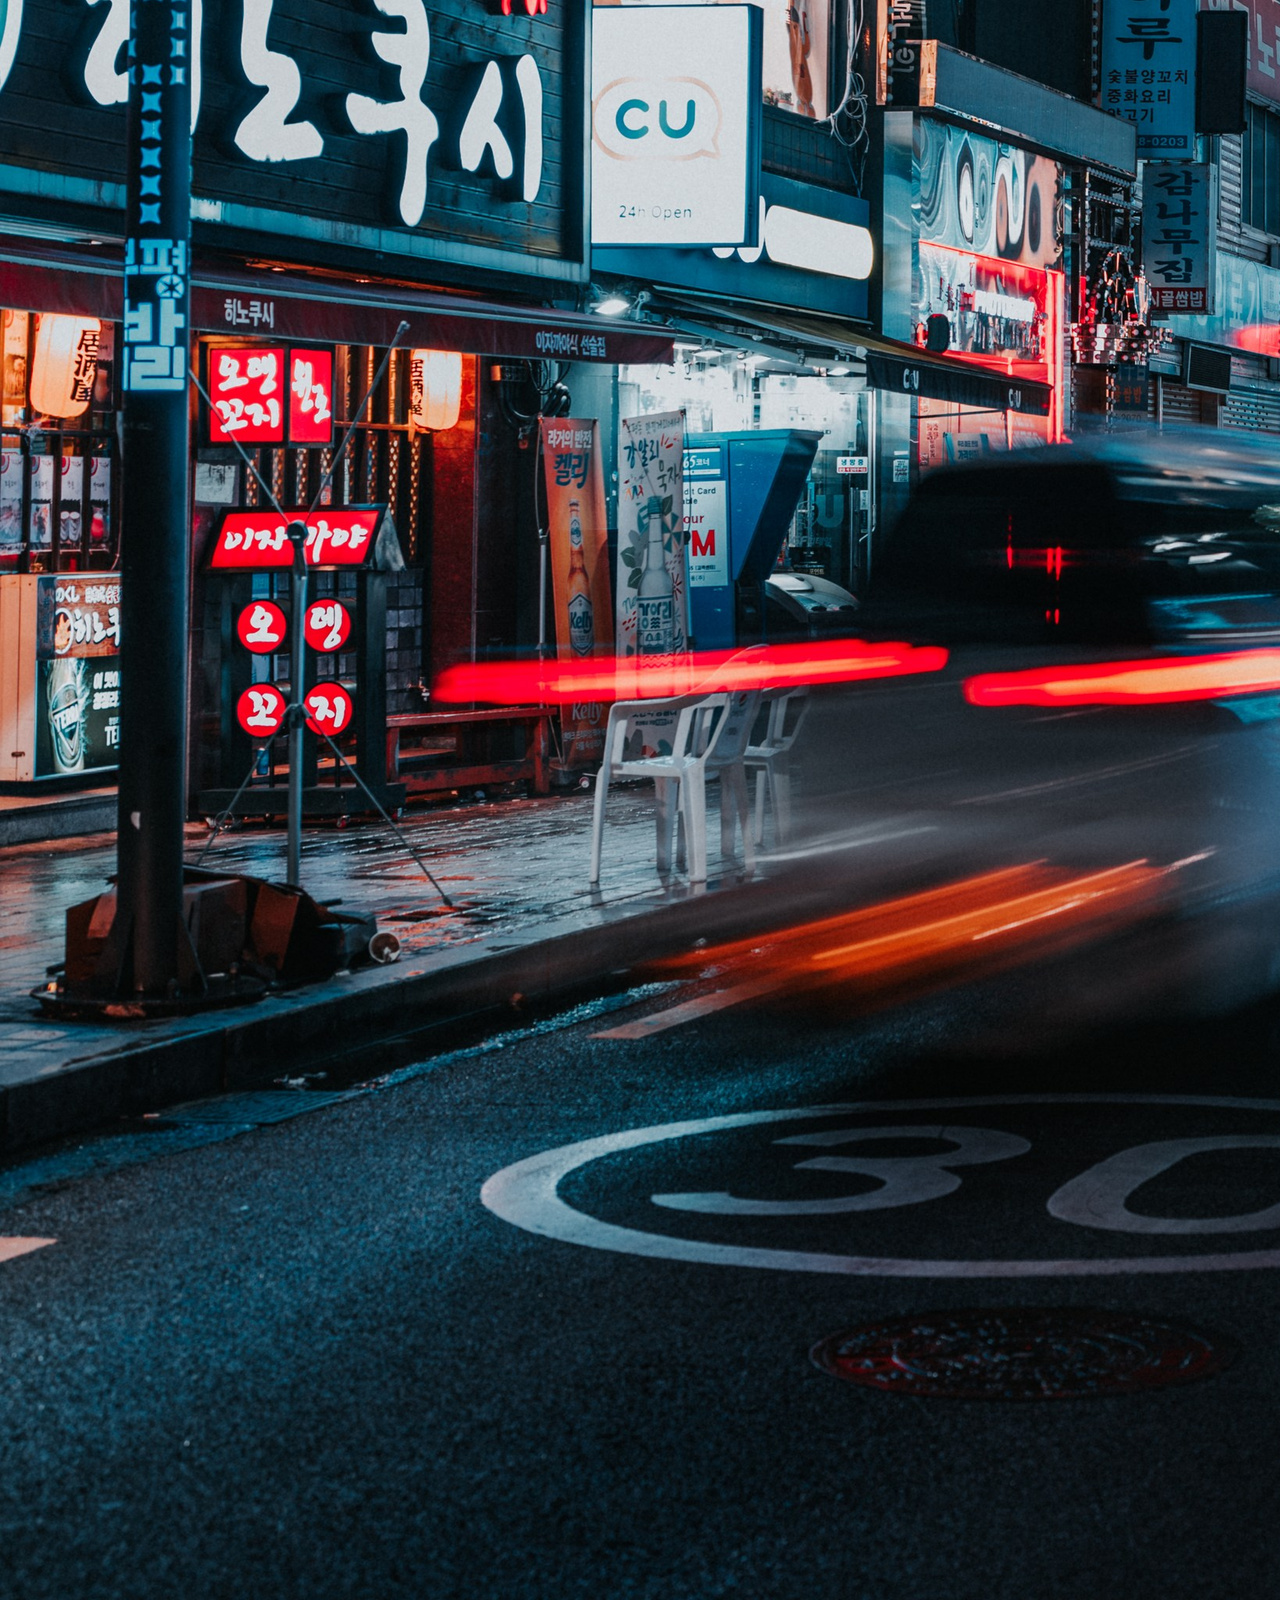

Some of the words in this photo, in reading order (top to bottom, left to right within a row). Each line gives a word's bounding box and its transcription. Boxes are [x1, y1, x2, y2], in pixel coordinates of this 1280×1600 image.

[1107, 67, 1189, 85] 숯불양꼬치
[1107, 88, 1172, 105] 중화요리
[616, 98, 696, 140] CU
[619, 205, 647, 219] 24h
[651, 205, 693, 222] Open
[1151, 171, 1200, 284] 감나무집
[224, 298, 275, 329] 히노쿠시
[580, 334, 607, 358] 선술집
[215, 397, 281, 434] 꼬지
[548, 428, 573, 448] 라거의
[574, 429, 593, 449] 반전
[552, 451, 590, 490] 켈리
[683, 455, 711, 469] 65코너
[697, 486, 717, 495] Card
[683, 515, 705, 525] our
[570, 611, 593, 634] Kelly
[572, 699, 604, 725] Kelly
